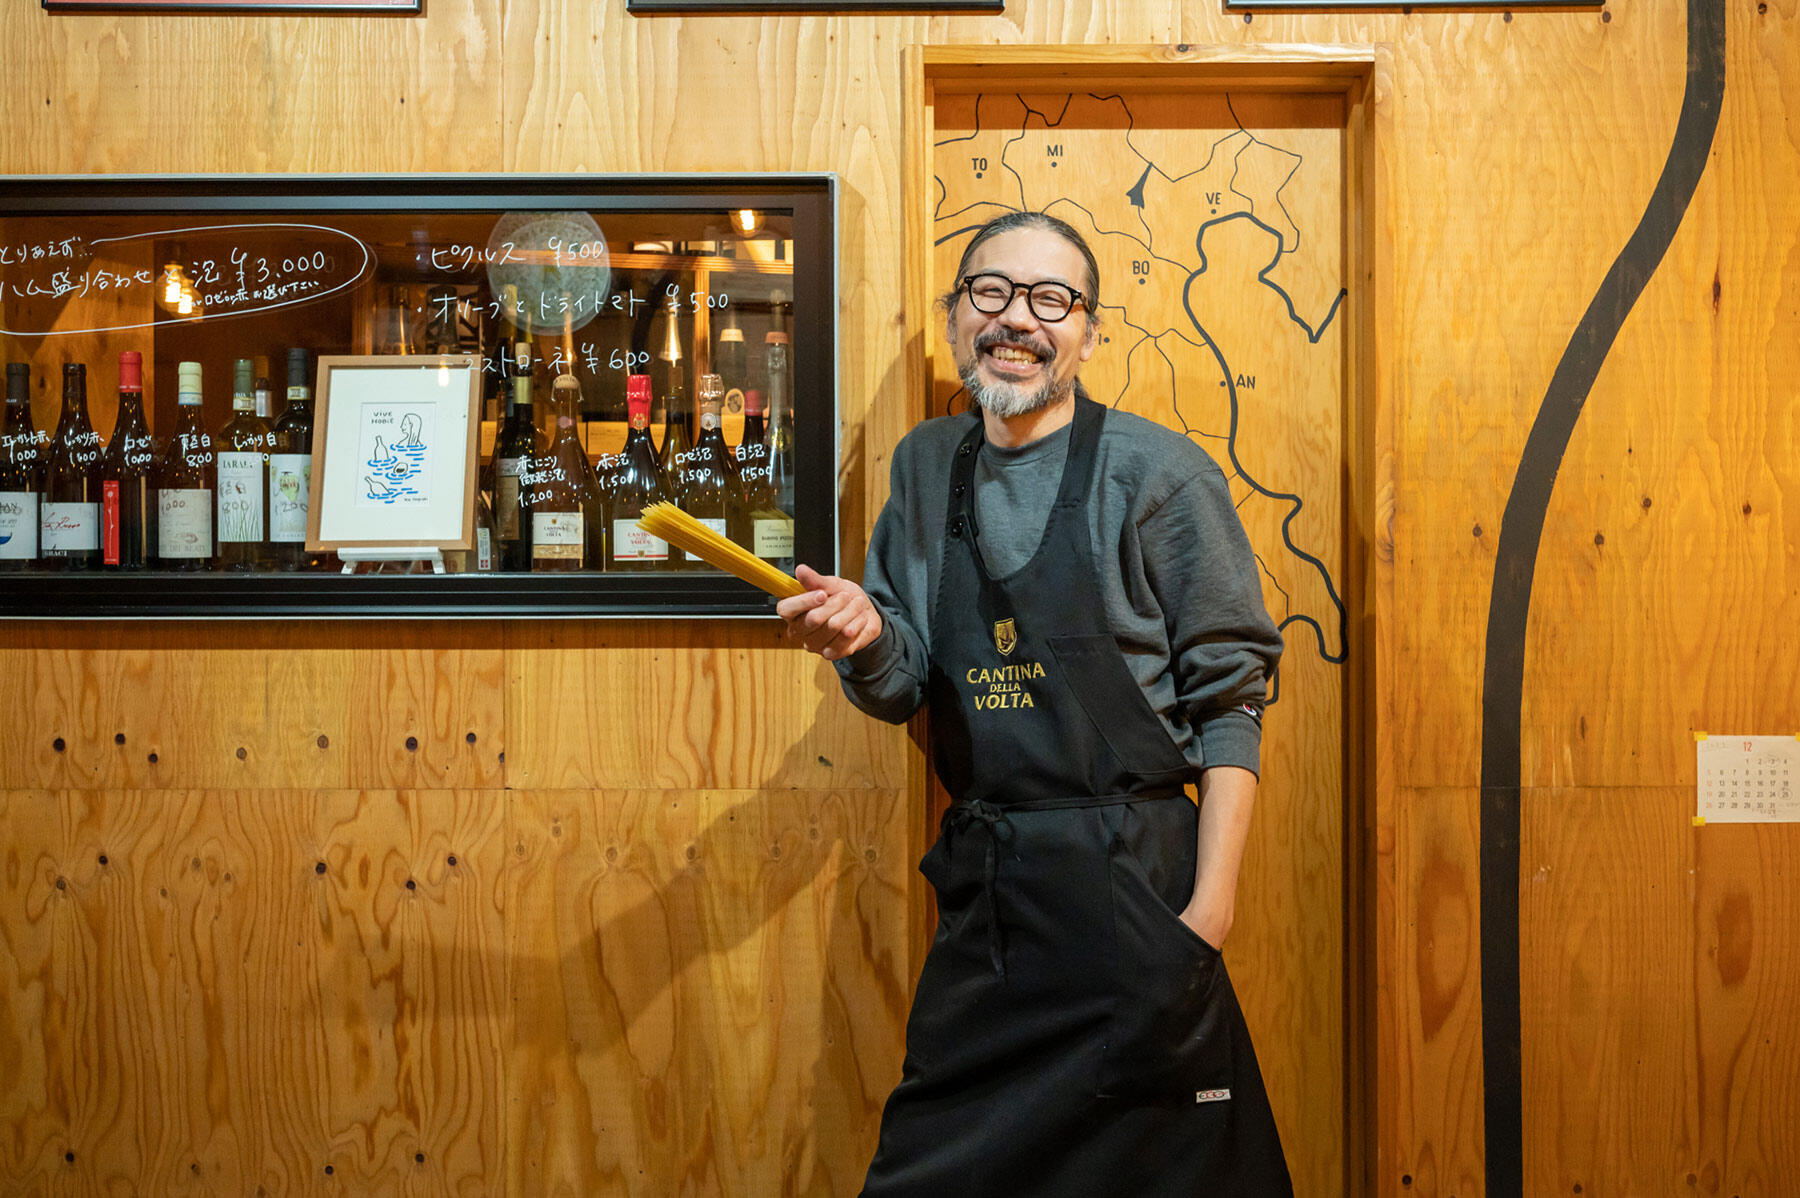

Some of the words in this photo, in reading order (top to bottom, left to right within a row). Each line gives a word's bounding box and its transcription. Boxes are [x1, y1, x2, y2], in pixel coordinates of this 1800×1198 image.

[1047, 145, 1063, 157] MI
[971, 157, 988, 171] TO
[1206, 192, 1221, 205] VE
[1132, 260, 1150, 275] BO
[1236, 374, 1256, 389] AN
[966, 662, 1046, 684] CANTINA
[989, 683, 1021, 693] DELLA
[974, 692, 1034, 711] VOLTA
[1743, 741, 1752, 752] 12
